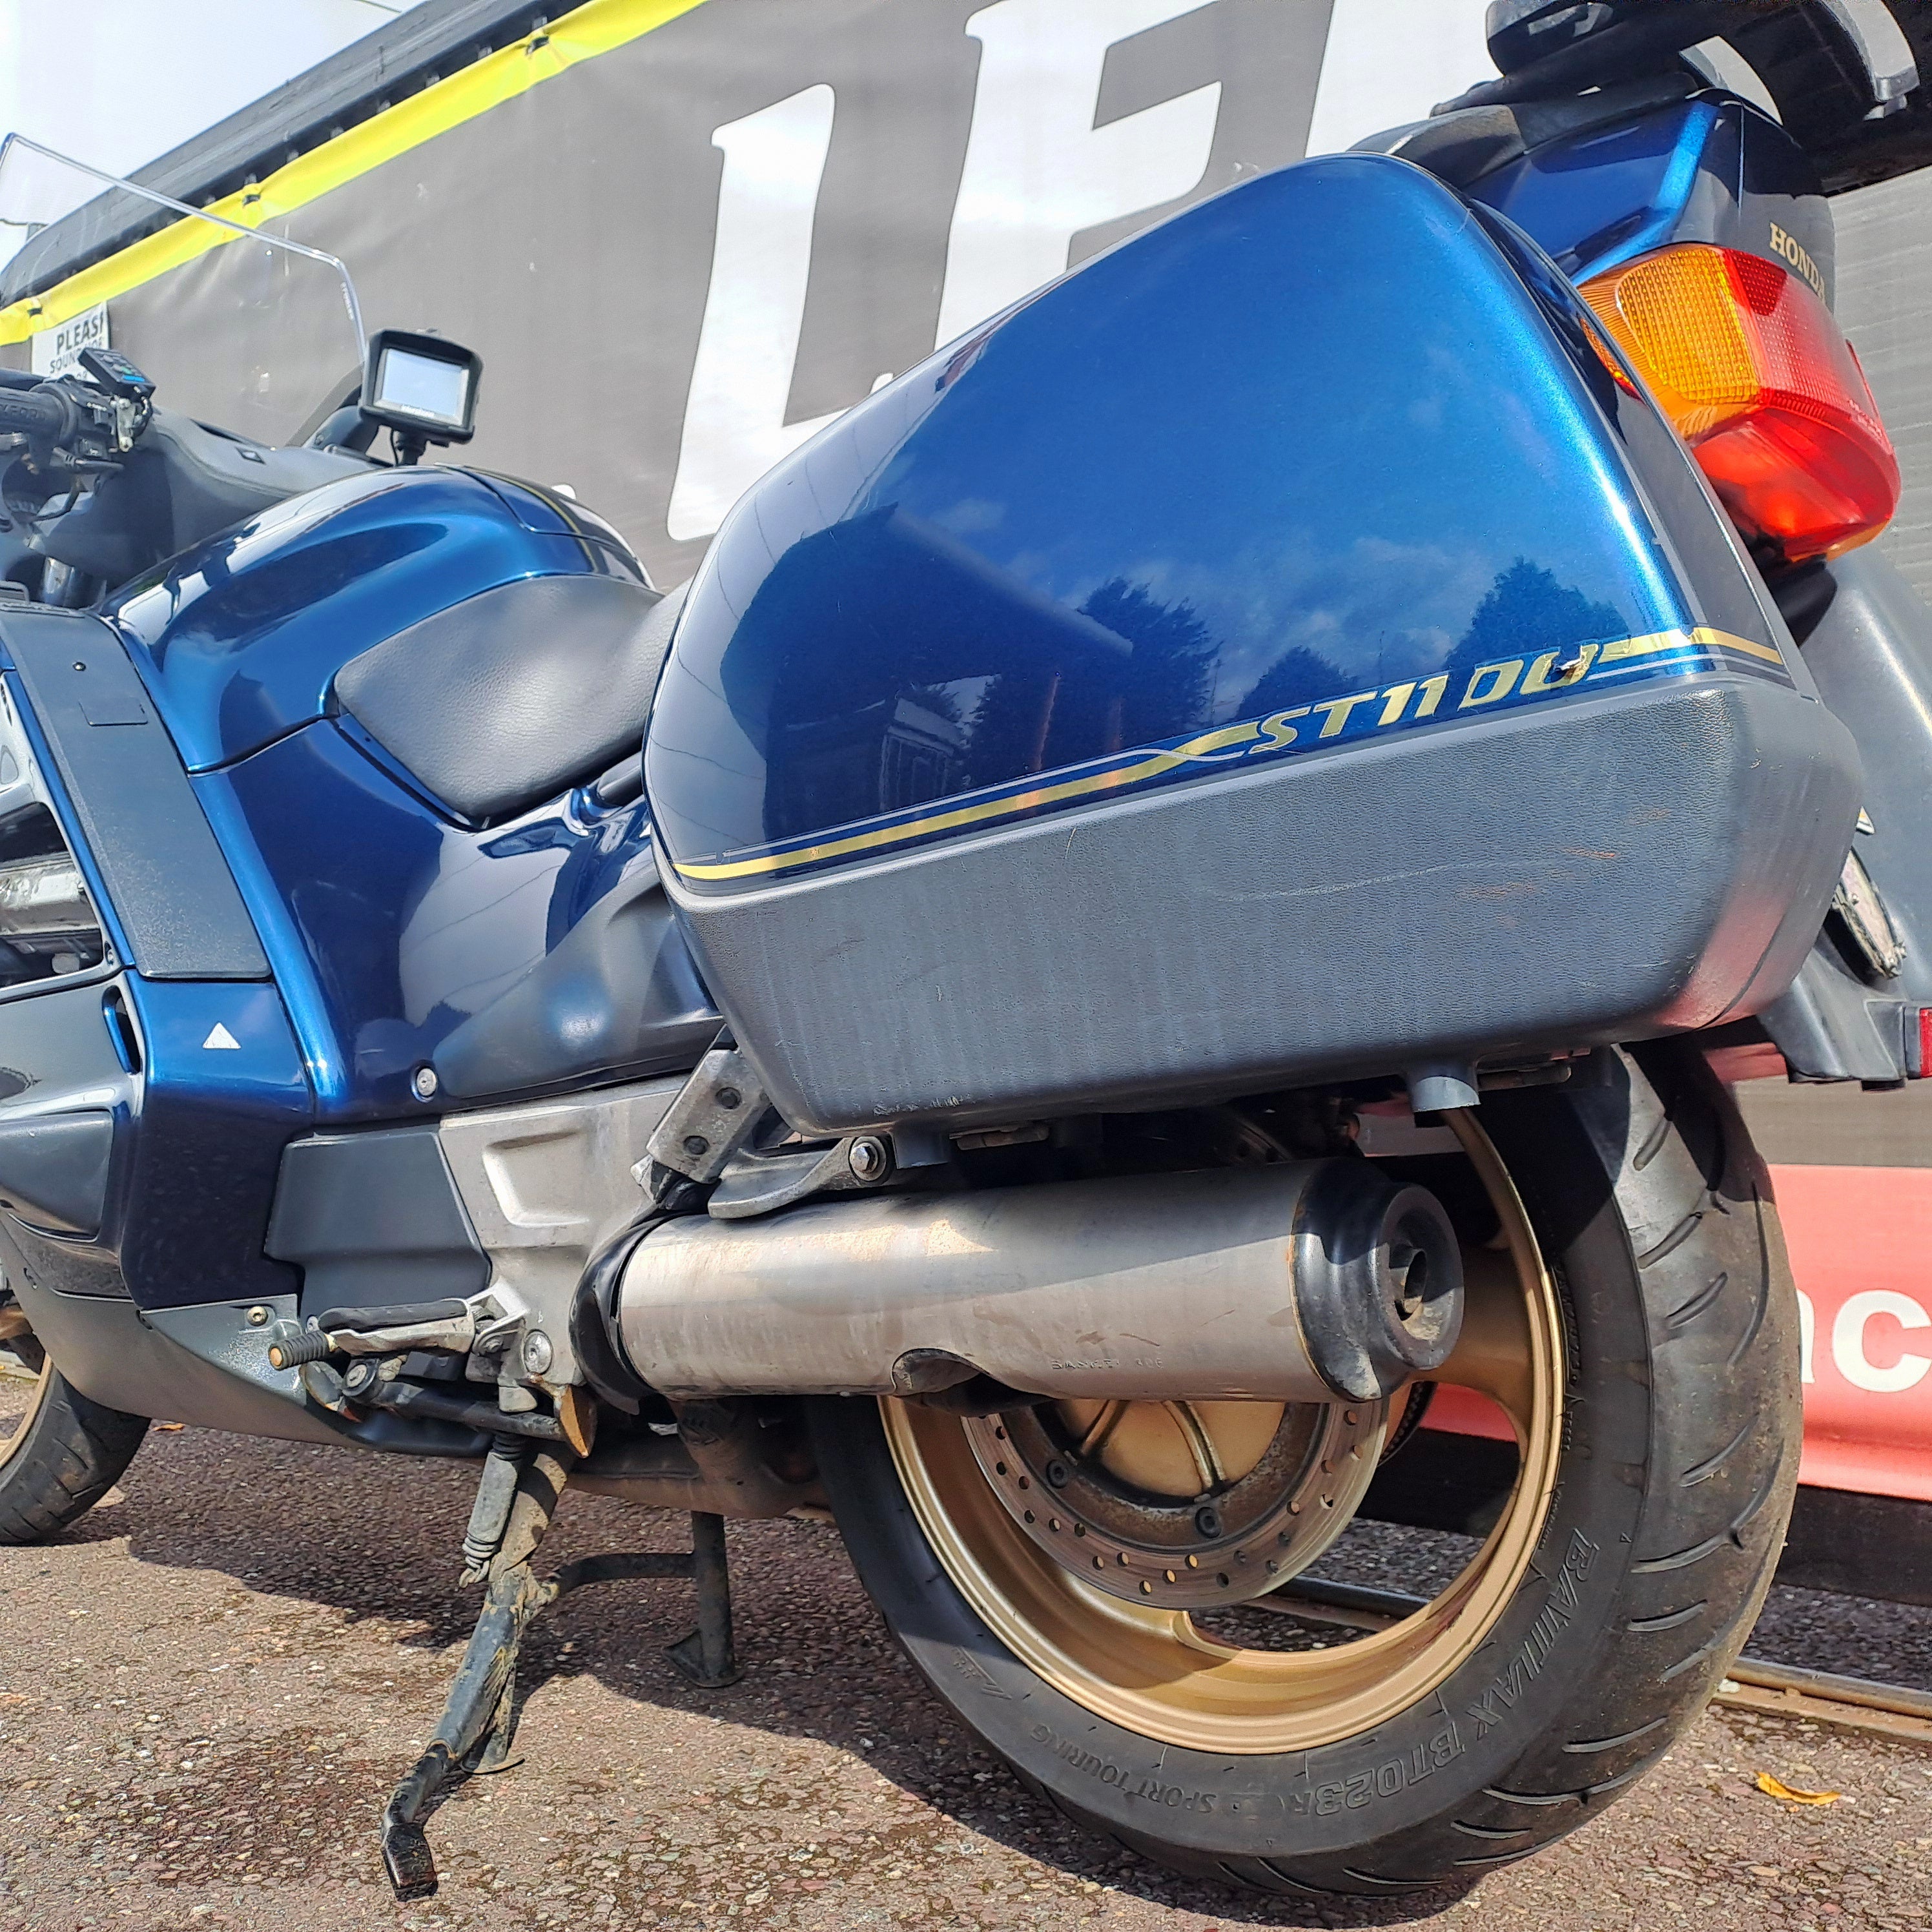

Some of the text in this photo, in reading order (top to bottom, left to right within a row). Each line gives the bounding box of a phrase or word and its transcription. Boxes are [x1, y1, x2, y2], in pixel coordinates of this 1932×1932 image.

[1769, 221, 1826, 307] HONDA
[1249, 643, 1599, 754] ST1100
[1027, 1723, 1217, 1815] SPORT TOURING
